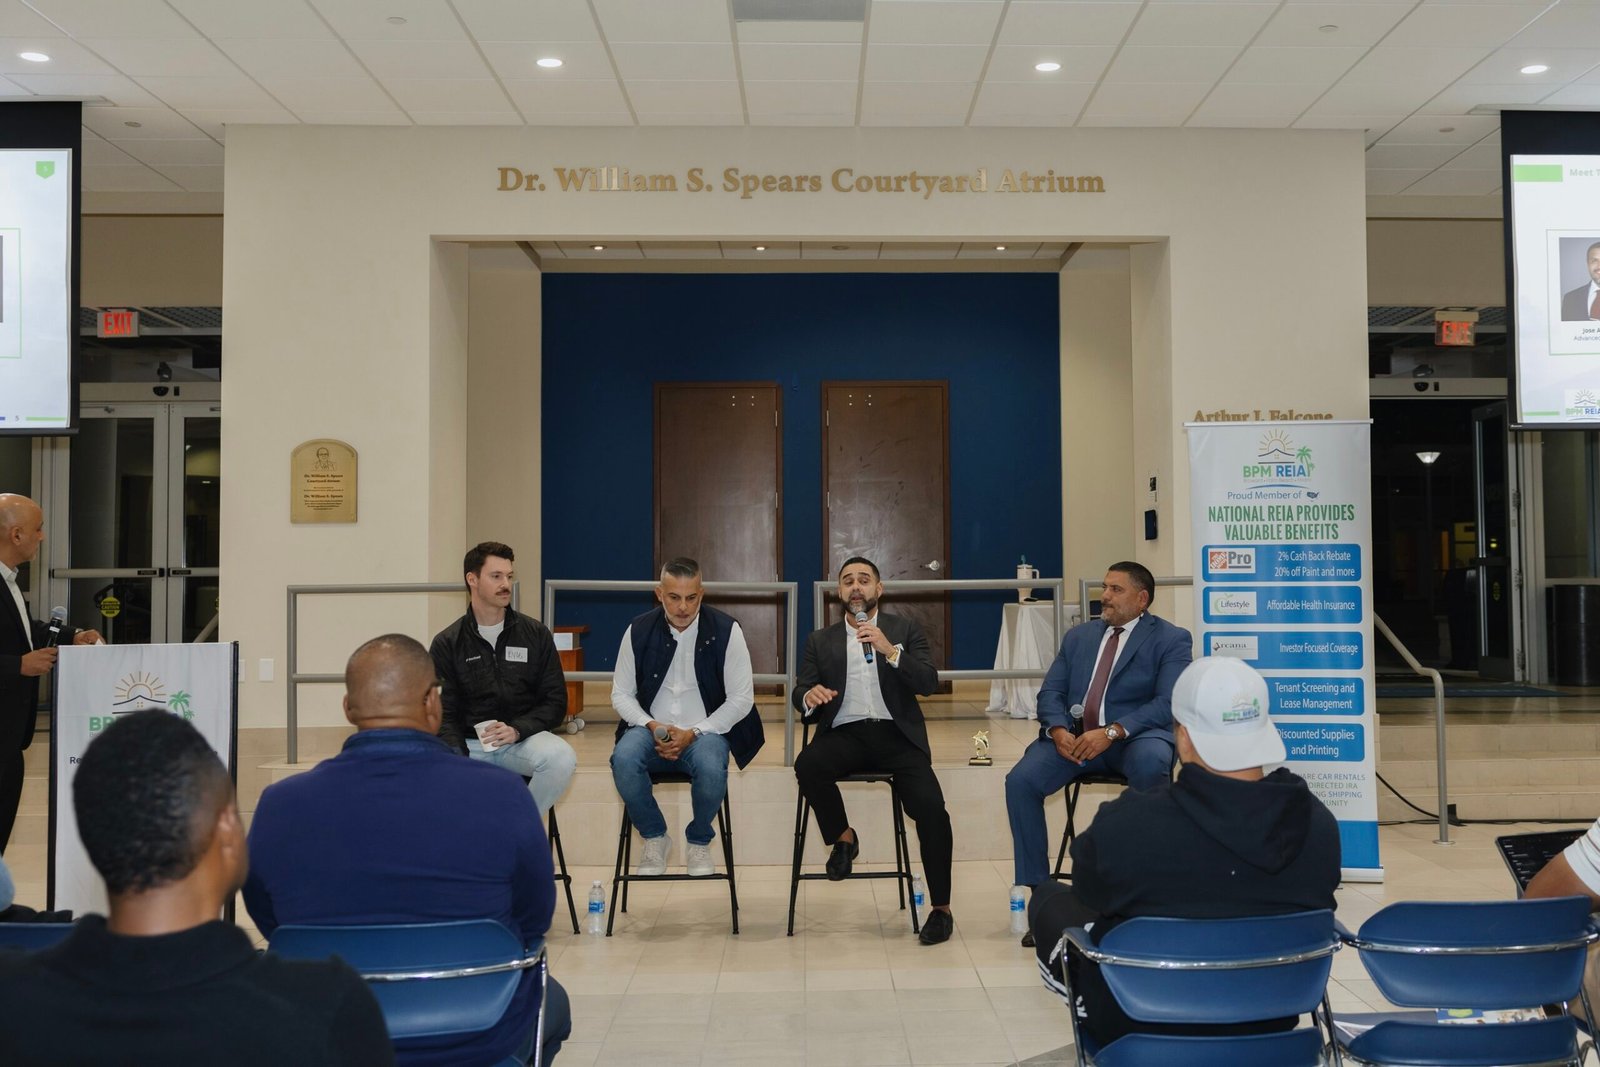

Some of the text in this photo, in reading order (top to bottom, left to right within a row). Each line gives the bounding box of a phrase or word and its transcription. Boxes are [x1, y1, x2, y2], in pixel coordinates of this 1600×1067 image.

[497, 166, 1106, 200] Dr. William S. Spears Courtyard Atrium
[104, 312, 132, 335] EXIT
[1269, 409, 1333, 421] Falcone
[1243, 465, 1306, 478] BPM REIA
[1227, 490, 1302, 500] Proud Member of
[1208, 504, 1355, 522] NATIONAL REIA PROVIDES
[1224, 523, 1339, 540] VALUABLE BENEFITS
[1228, 551, 1251, 564] Pro
[1278, 550, 1351, 561] 2% Cash Back Rebate
[1274, 567, 1356, 577] 20% off Paint and more
[1221, 600, 1250, 609] Lifestyle
[1267, 600, 1355, 610] Affordable Health Insurance
[1279, 643, 1358, 655] Investor Focused Coverage
[1275, 682, 1355, 695] Tenant Screening and
[1280, 698, 1352, 711] Lease Management
[89, 716, 114, 731] BP
[1321, 729, 1355, 741] Supplies
[1291, 744, 1339, 757] and Printing
